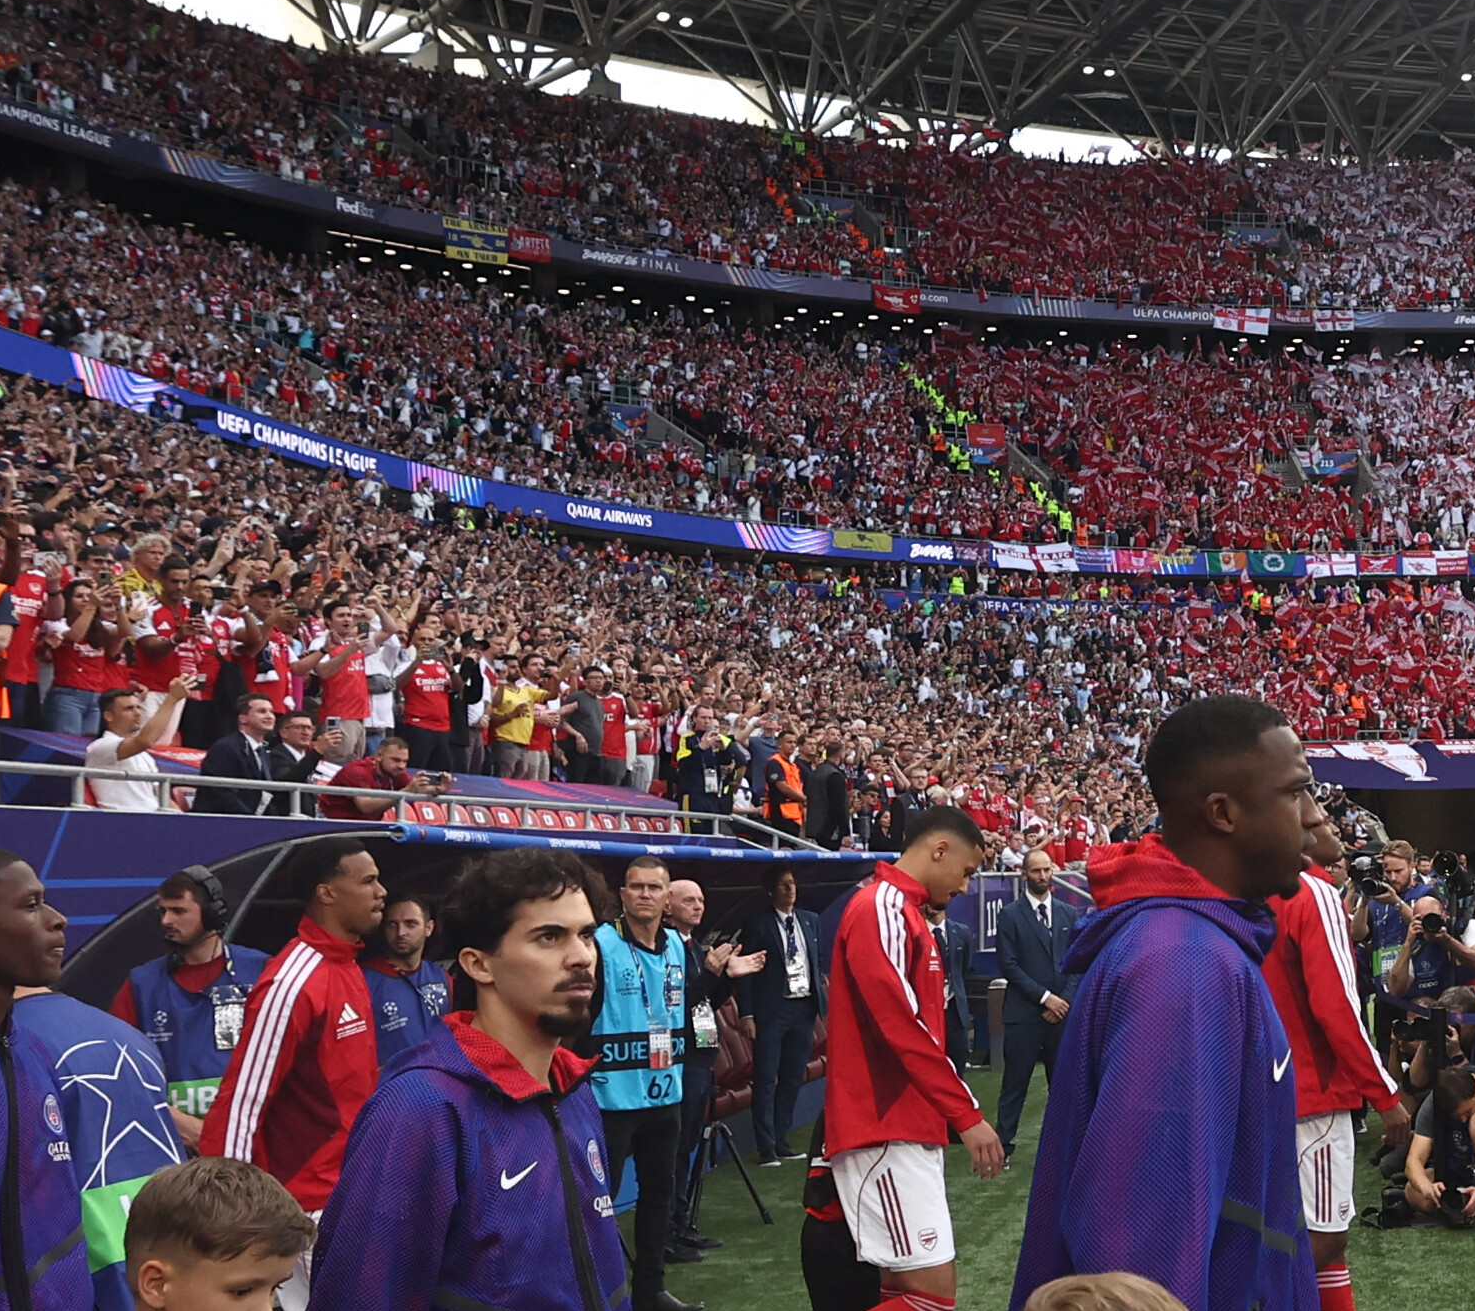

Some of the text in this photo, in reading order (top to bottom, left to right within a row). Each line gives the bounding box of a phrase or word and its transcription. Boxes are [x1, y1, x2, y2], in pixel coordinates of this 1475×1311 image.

[63, 122, 112, 148] LEAGUE
[336, 196, 375, 219] FedEx
[642, 257, 682, 274] FINAL
[919, 293, 949, 304] o.com
[1133, 308, 1216, 322] UEFA CHAMPION
[217, 410, 378, 473] UEFA CHAMPIONS LEAGUE
[1319, 459, 1334, 468] 213
[566, 502, 654, 528] QATAR AIRWAYS
[910, 543, 954, 560] BUDAPE
[1052, 552, 1071, 560] AFC
[647, 1074, 673, 1101] 62
[171, 1085, 216, 1116] HB
